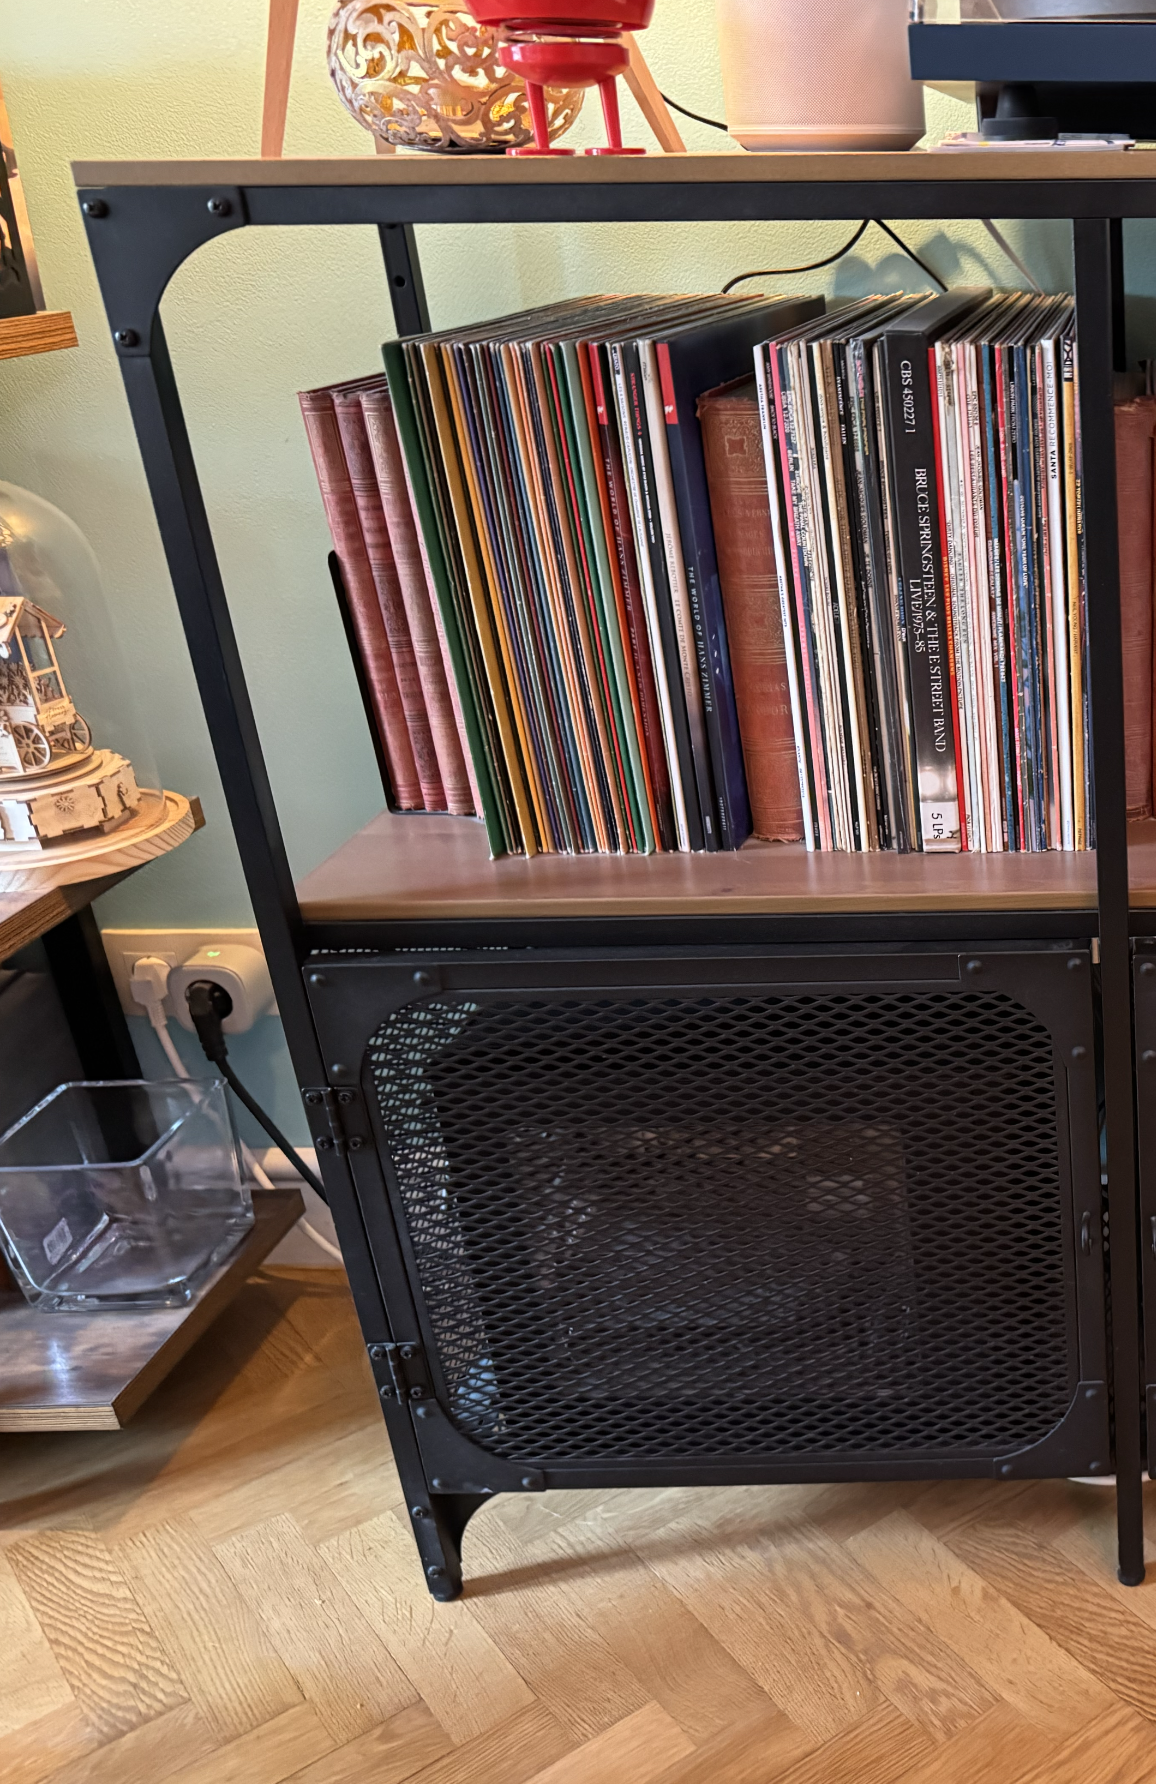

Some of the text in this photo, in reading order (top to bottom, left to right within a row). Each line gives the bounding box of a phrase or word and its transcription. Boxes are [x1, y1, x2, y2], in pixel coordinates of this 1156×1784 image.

[765, 373, 773, 398] WINEHOUSE
[899, 360, 912, 385] CBS
[628, 372, 642, 429] STRANGER THINGS
[835, 376, 844, 414] EVANESCENCE
[901, 387, 916, 425] 450227
[1045, 360, 1057, 479] SANTA RECOMMENCE-MOI
[603, 458, 612, 475] THE
[969, 461, 977, 507] RESTAURANTS
[607, 481, 617, 514] WORLD
[792, 495, 797, 505] MY
[855, 469, 868, 543] JEAN-JACQUES GOLDMAN
[972, 507, 977, 516] DU
[613, 519, 620, 530] OF
[615, 536, 625, 565] HANS
[800, 530, 809, 566] COUNTDOWN
[620, 569, 632, 611] ZIMMER
[665, 533, 693, 697] JÉRÔME REBOTIER LE COMTE DE MONTE CRISTO
[914, 468, 946, 751] BRUCE SPRINGSTEEN & THE E STREET BAND
[951, 600, 959, 637] SOUNDTRACK
[629, 627, 637, 651] PART
[687, 567, 713, 712] THE WORLD OF HANS ZIMMER
[638, 691, 649, 736] DIMENSION
[931, 823, 942, 839] LPs
